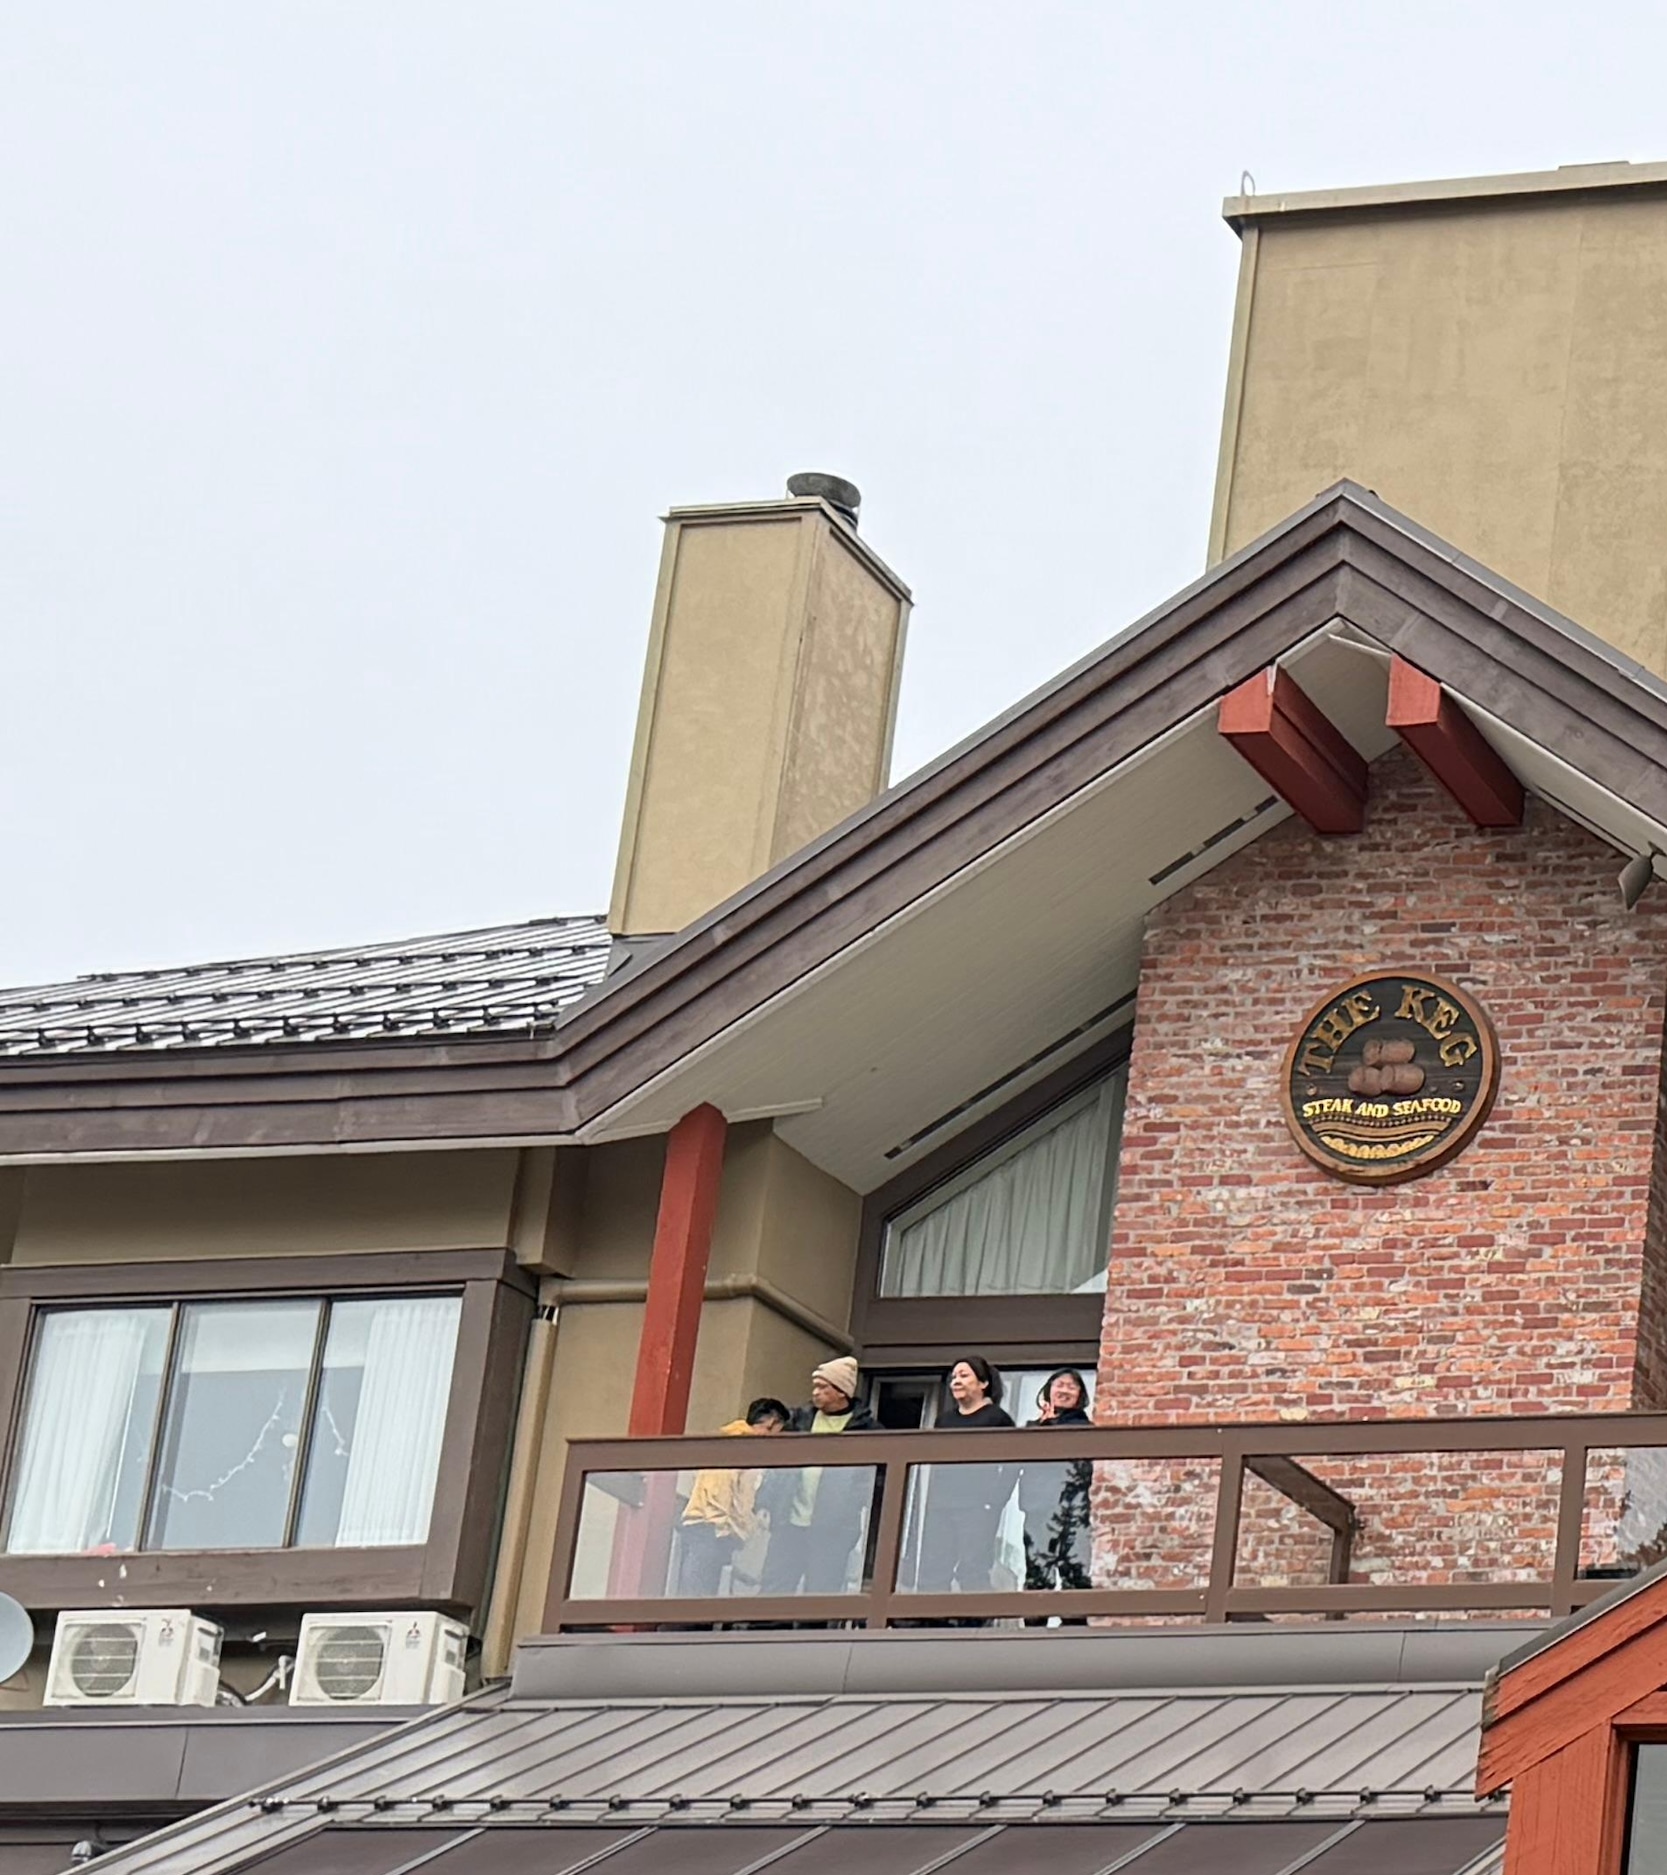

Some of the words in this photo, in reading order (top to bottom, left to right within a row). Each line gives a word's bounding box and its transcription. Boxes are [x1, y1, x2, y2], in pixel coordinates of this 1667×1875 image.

[1298, 989, 1382, 1077] THE
[1394, 984, 1478, 1068] KEG
[1302, 1098, 1353, 1118] STEAK
[1354, 1102, 1389, 1118] AND
[1392, 1097, 1462, 1117] SEAFOOD
